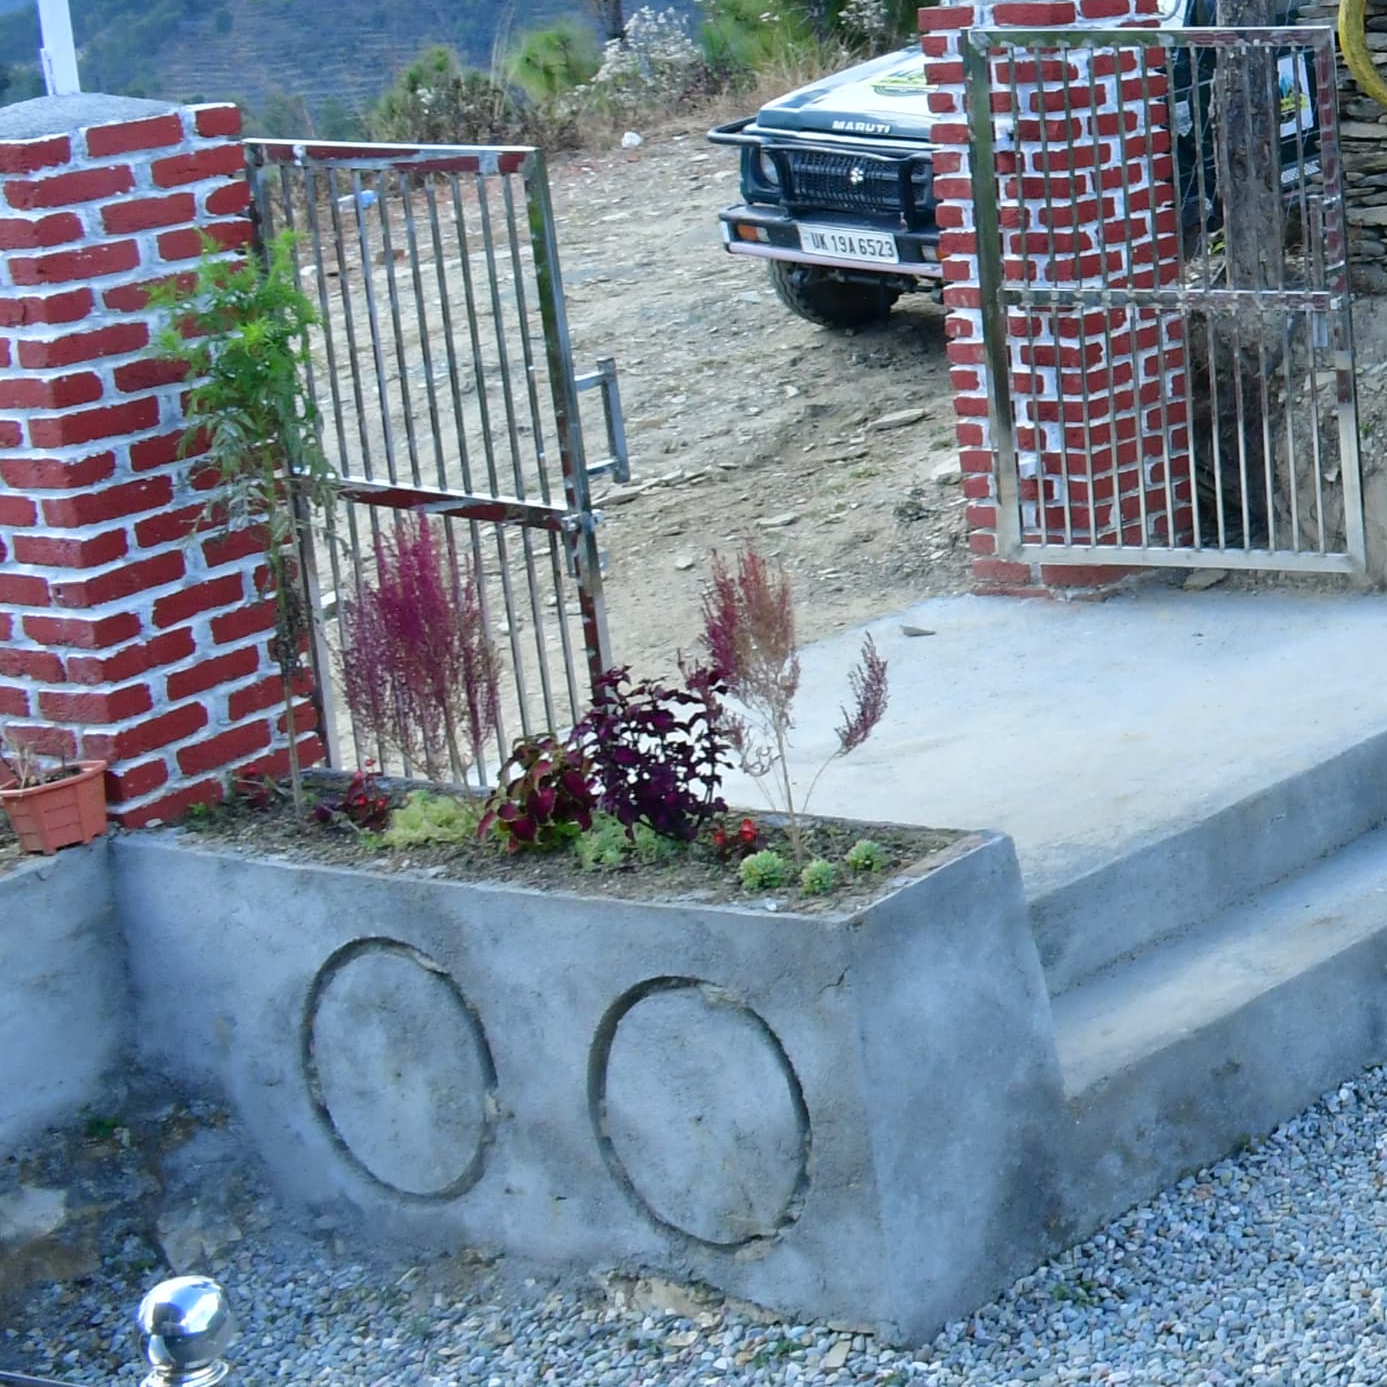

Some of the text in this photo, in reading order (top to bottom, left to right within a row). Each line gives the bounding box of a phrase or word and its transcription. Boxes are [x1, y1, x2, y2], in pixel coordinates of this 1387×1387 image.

[832, 120, 891, 134] MARUTI
[811, 232, 895, 258] UK 19A 6523
